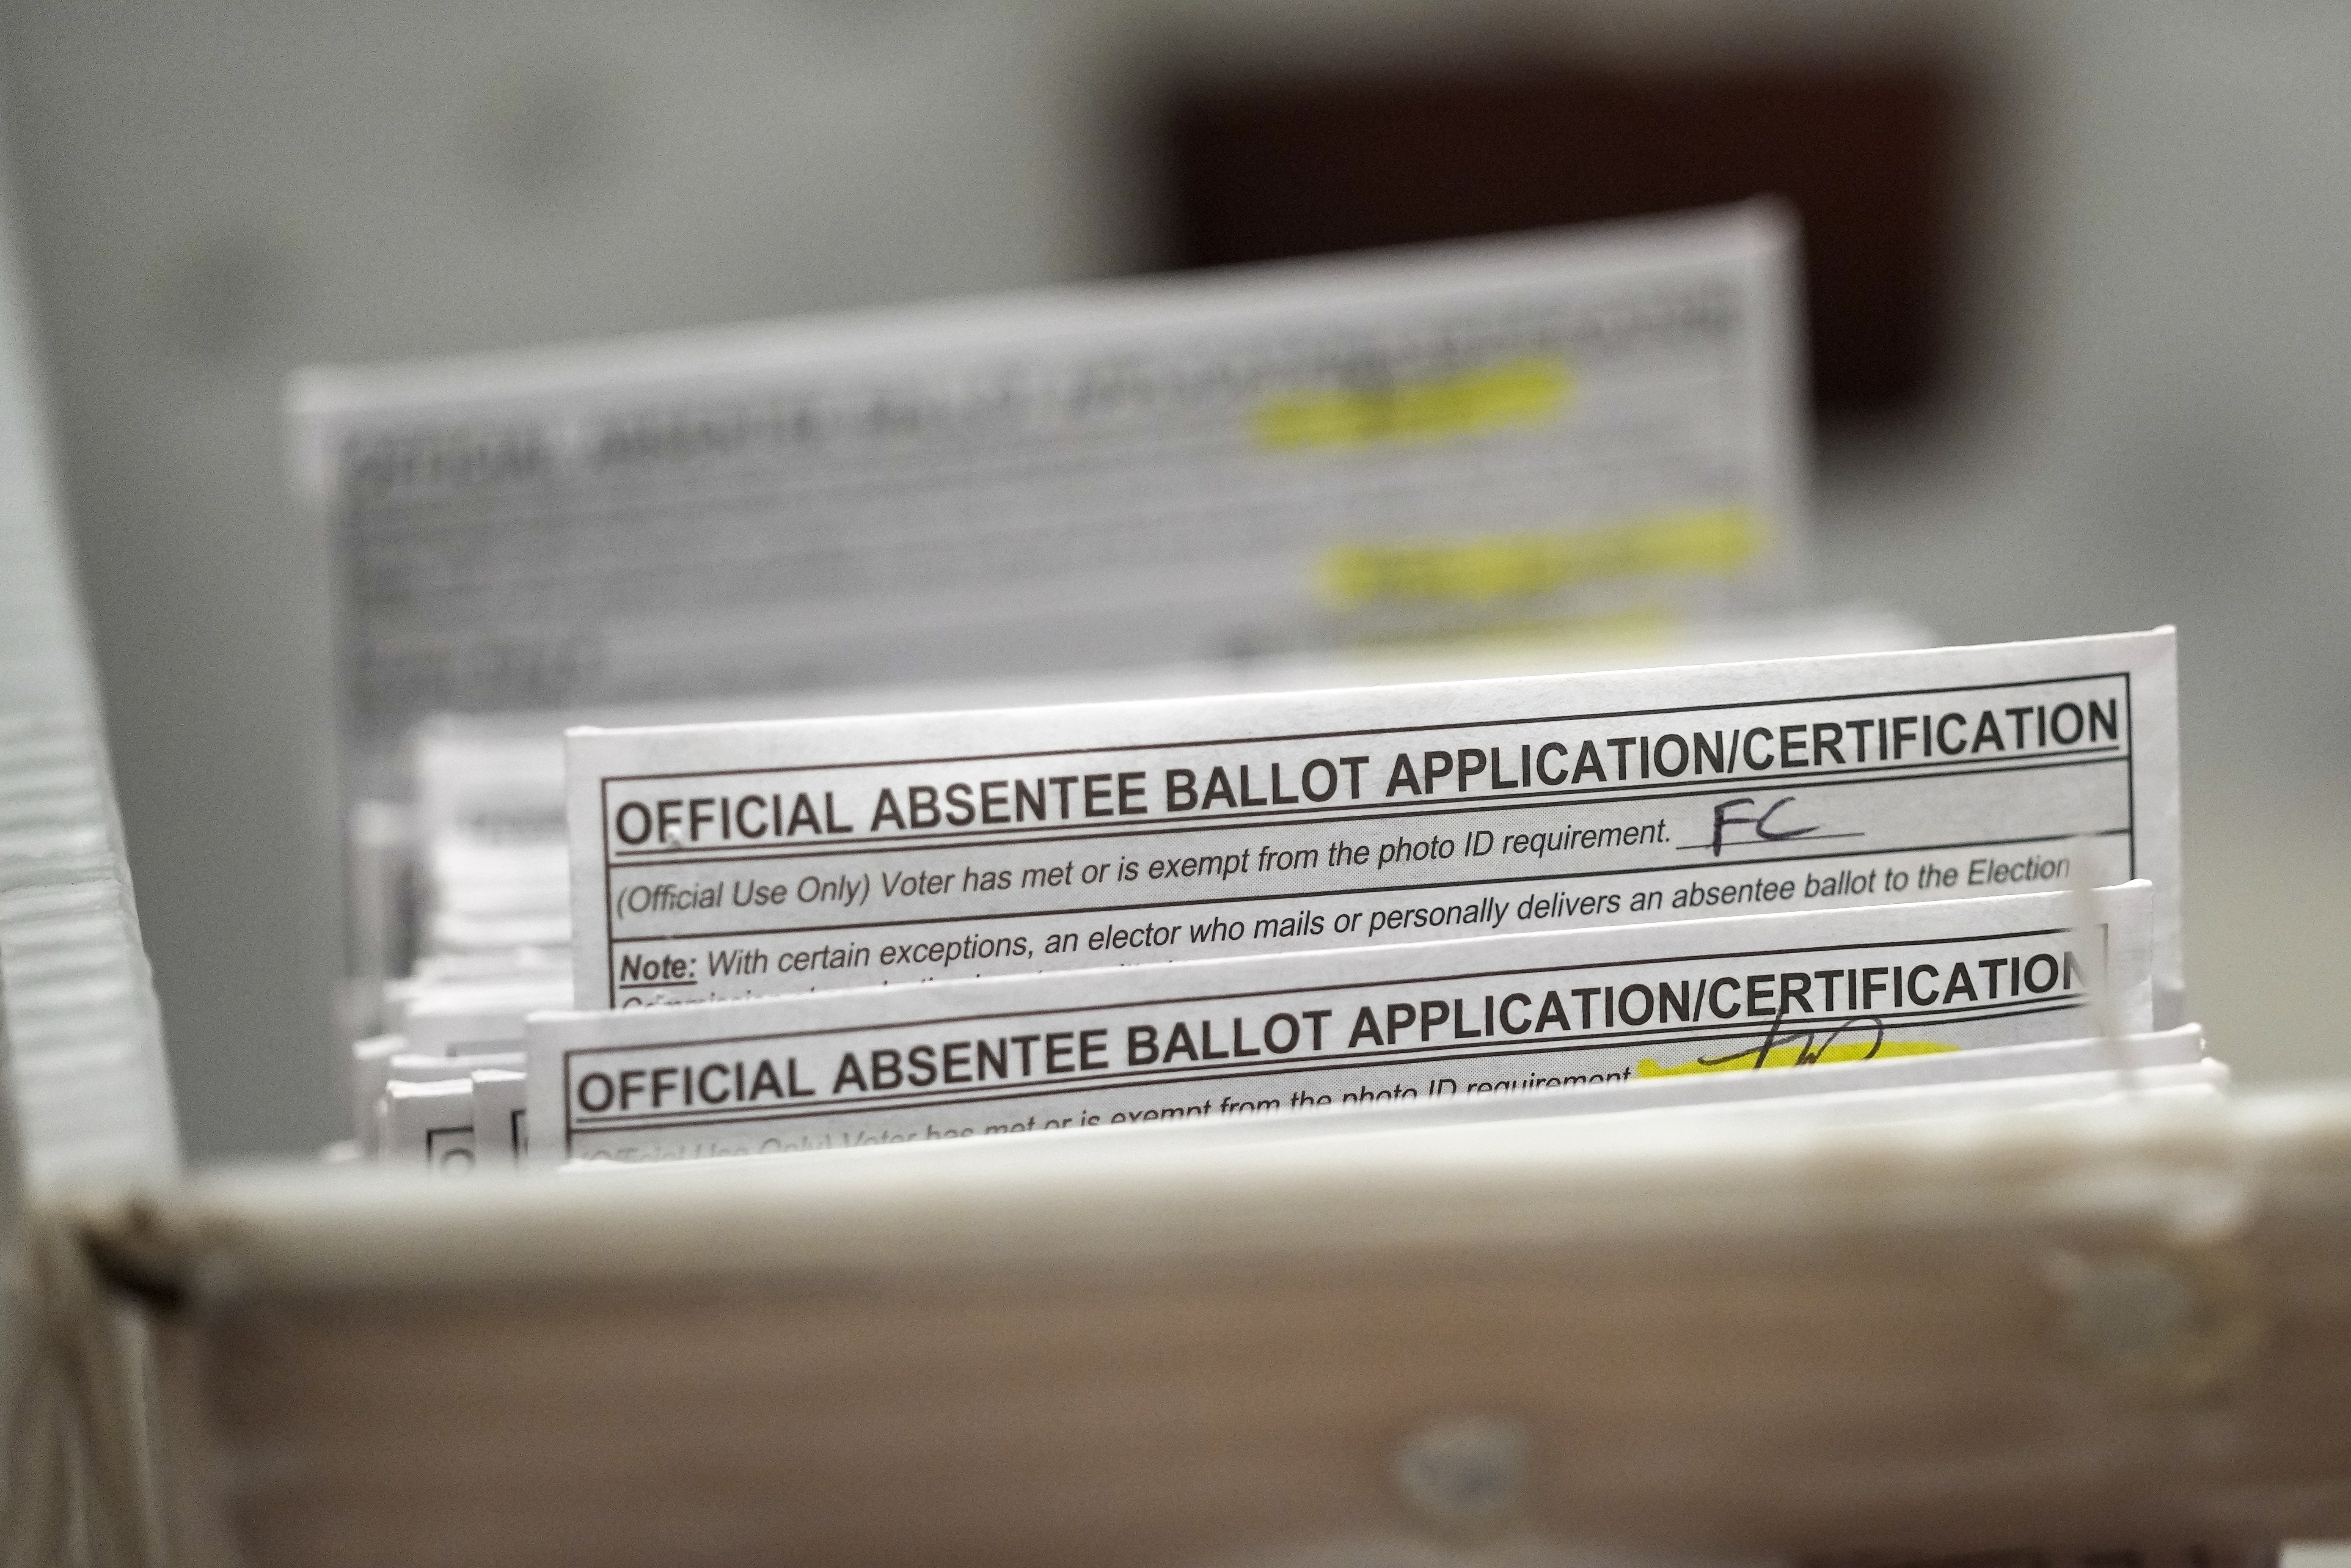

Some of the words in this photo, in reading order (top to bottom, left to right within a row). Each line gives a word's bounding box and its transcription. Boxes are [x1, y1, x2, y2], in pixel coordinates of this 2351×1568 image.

[616, 792, 853, 845] OFFICIAL
[870, 772, 1147, 832] ABSENTEE
[1166, 756, 1370, 812] BALLOT
[1386, 698, 2118, 797] APPLICATION/CERTIFICATION
[616, 880, 723, 919] (Official
[733, 880, 787, 905] Use
[798, 873, 870, 906] Only)
[882, 870, 955, 897] Voter
[963, 866, 1012, 892] has
[1021, 861, 1074, 888] met
[1082, 863, 1110, 884] or
[1117, 856, 1139, 881] is
[1148, 848, 1250, 880] exempt
[1258, 846, 1319, 872] from
[1328, 840, 1370, 867] the
[1377, 834, 1455, 870] photo
[1464, 831, 1494, 857] ID
[1502, 817, 1671, 860] requirement.
[620, 954, 696, 982] Note:
[708, 948, 768, 977] With
[777, 942, 871, 972] certain
[879, 932, 1034, 966] exceptions,
[1044, 933, 1079, 954] an
[1088, 922, 1181, 951] elector
[1189, 916, 1244, 944] who
[1254, 910, 1324, 939] mails
[1334, 912, 1362, 933] or
[1368, 893, 1509, 938] personally
[1517, 885, 1621, 922] delivers
[1629, 888, 1663, 912] an
[1671, 874, 1795, 909] absentee
[1803, 866, 1875, 898] ballot
[1885, 867, 1909, 890] to
[1917, 862, 1959, 889] the
[1967, 854, 2070, 886] Election
[577, 1057, 815, 1113] OFFICIAL
[832, 1029, 1108, 1094] ABSENTEE
[1127, 1009, 1332, 1066] BALLOT
